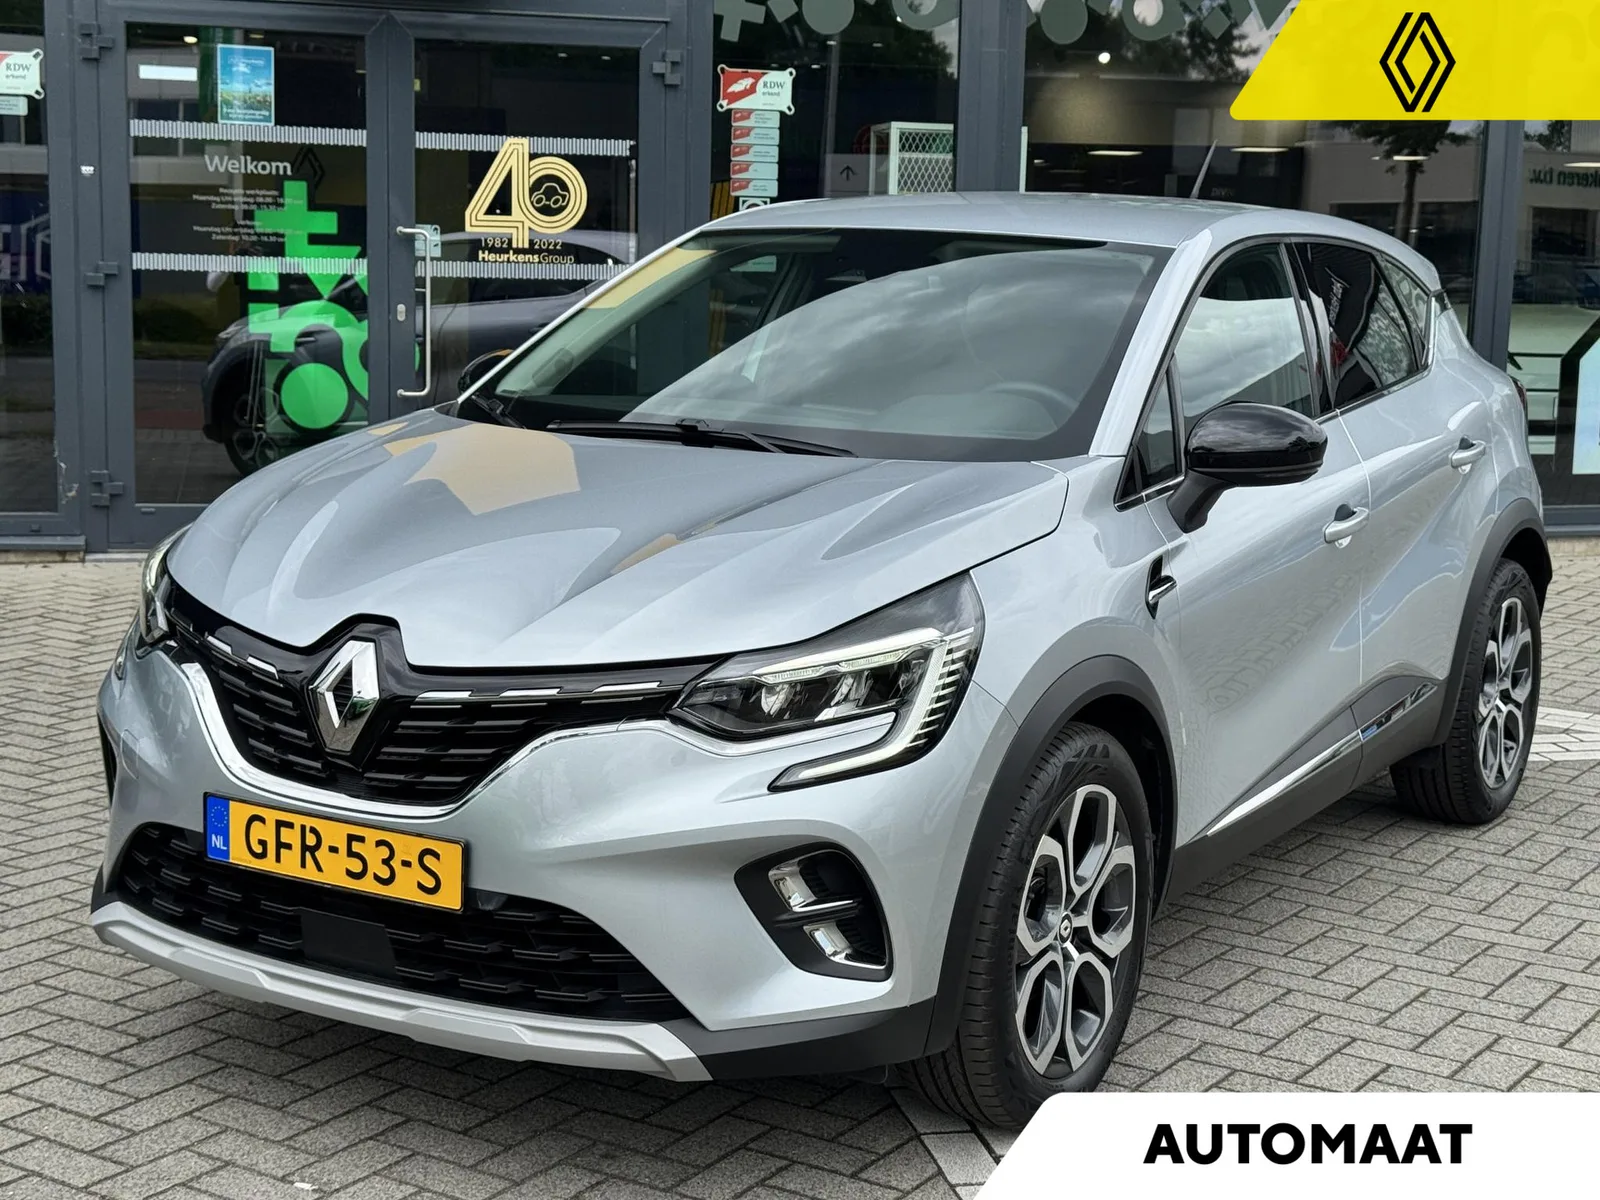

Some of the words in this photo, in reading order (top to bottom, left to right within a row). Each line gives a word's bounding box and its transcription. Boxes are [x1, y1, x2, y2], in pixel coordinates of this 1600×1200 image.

[5, 62, 32, 72] RDW
[762, 80, 785, 89] RDW
[204, 154, 293, 176] Welkom
[464, 137, 588, 249] 40
[481, 237, 509, 248] 1982
[533, 239, 562, 250] 2022
[211, 833, 228, 850] NL
[244, 813, 442, 896] GFR-53-S
